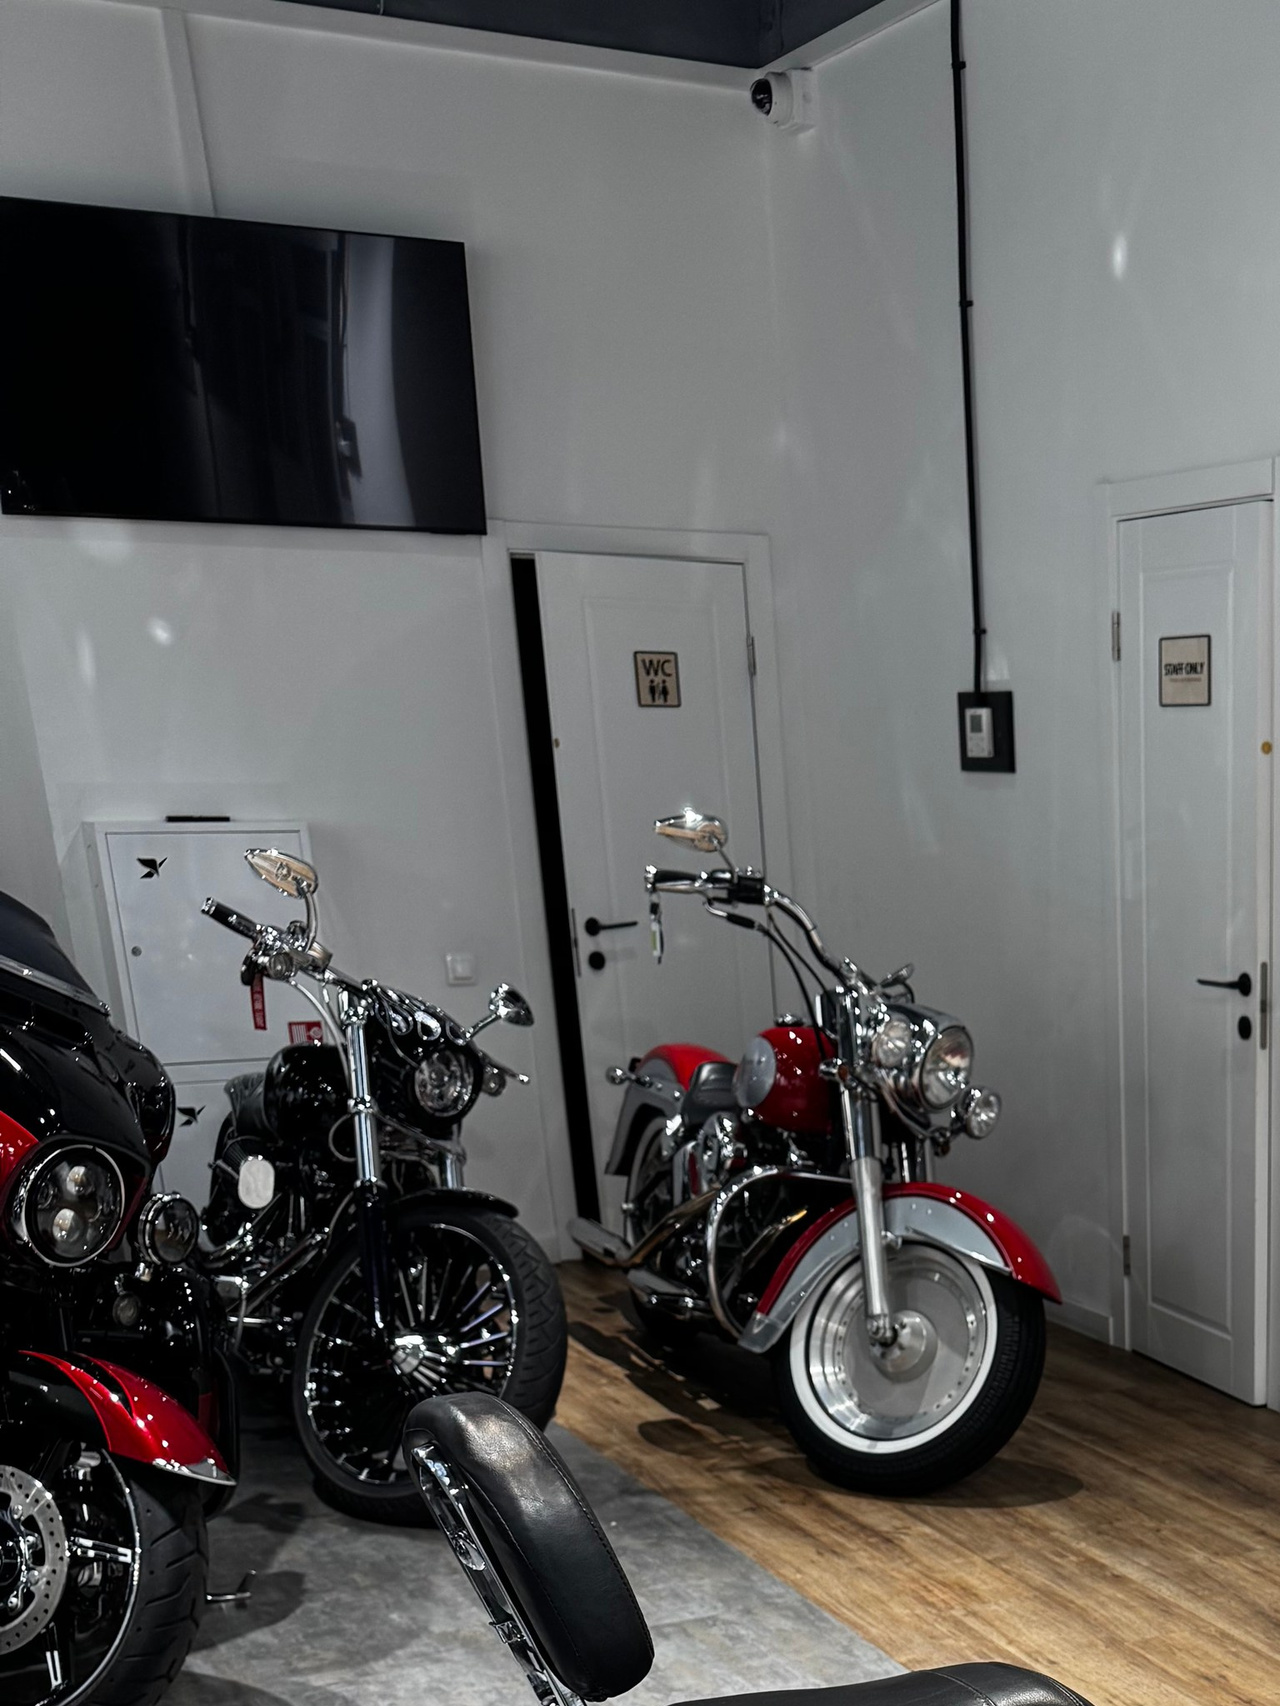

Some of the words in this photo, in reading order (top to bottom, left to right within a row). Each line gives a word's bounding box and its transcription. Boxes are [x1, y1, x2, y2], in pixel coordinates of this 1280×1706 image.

[641, 658, 673, 677] WC
[1164, 662, 1184, 676] STAFF
[1185, 661, 1206, 675] ONLY
